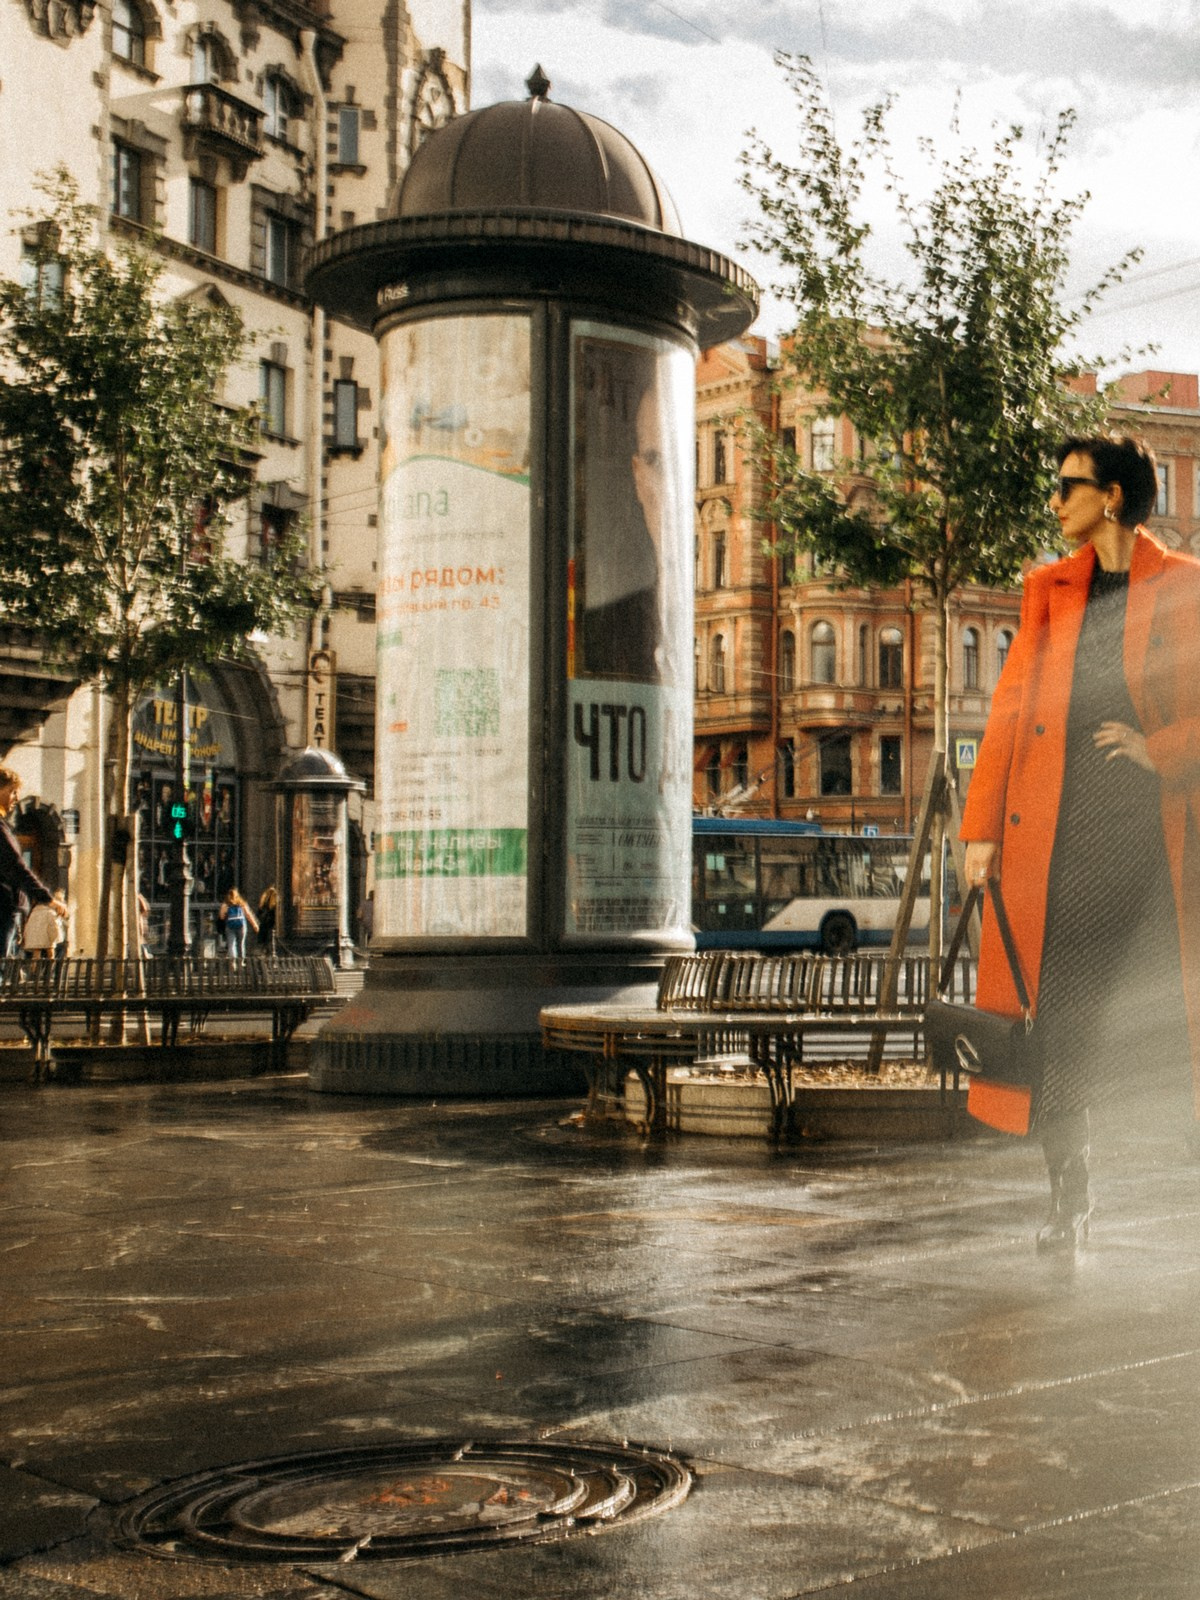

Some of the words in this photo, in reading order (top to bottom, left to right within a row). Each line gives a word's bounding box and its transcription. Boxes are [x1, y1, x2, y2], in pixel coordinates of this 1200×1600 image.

[411, 565, 505, 593] рядом:
[313, 692, 327, 748] ТЕАТ
[162, 727, 198, 743] ИМИ
[573, 703, 647, 783] ЧТО
[418, 837, 502, 851] анализы
